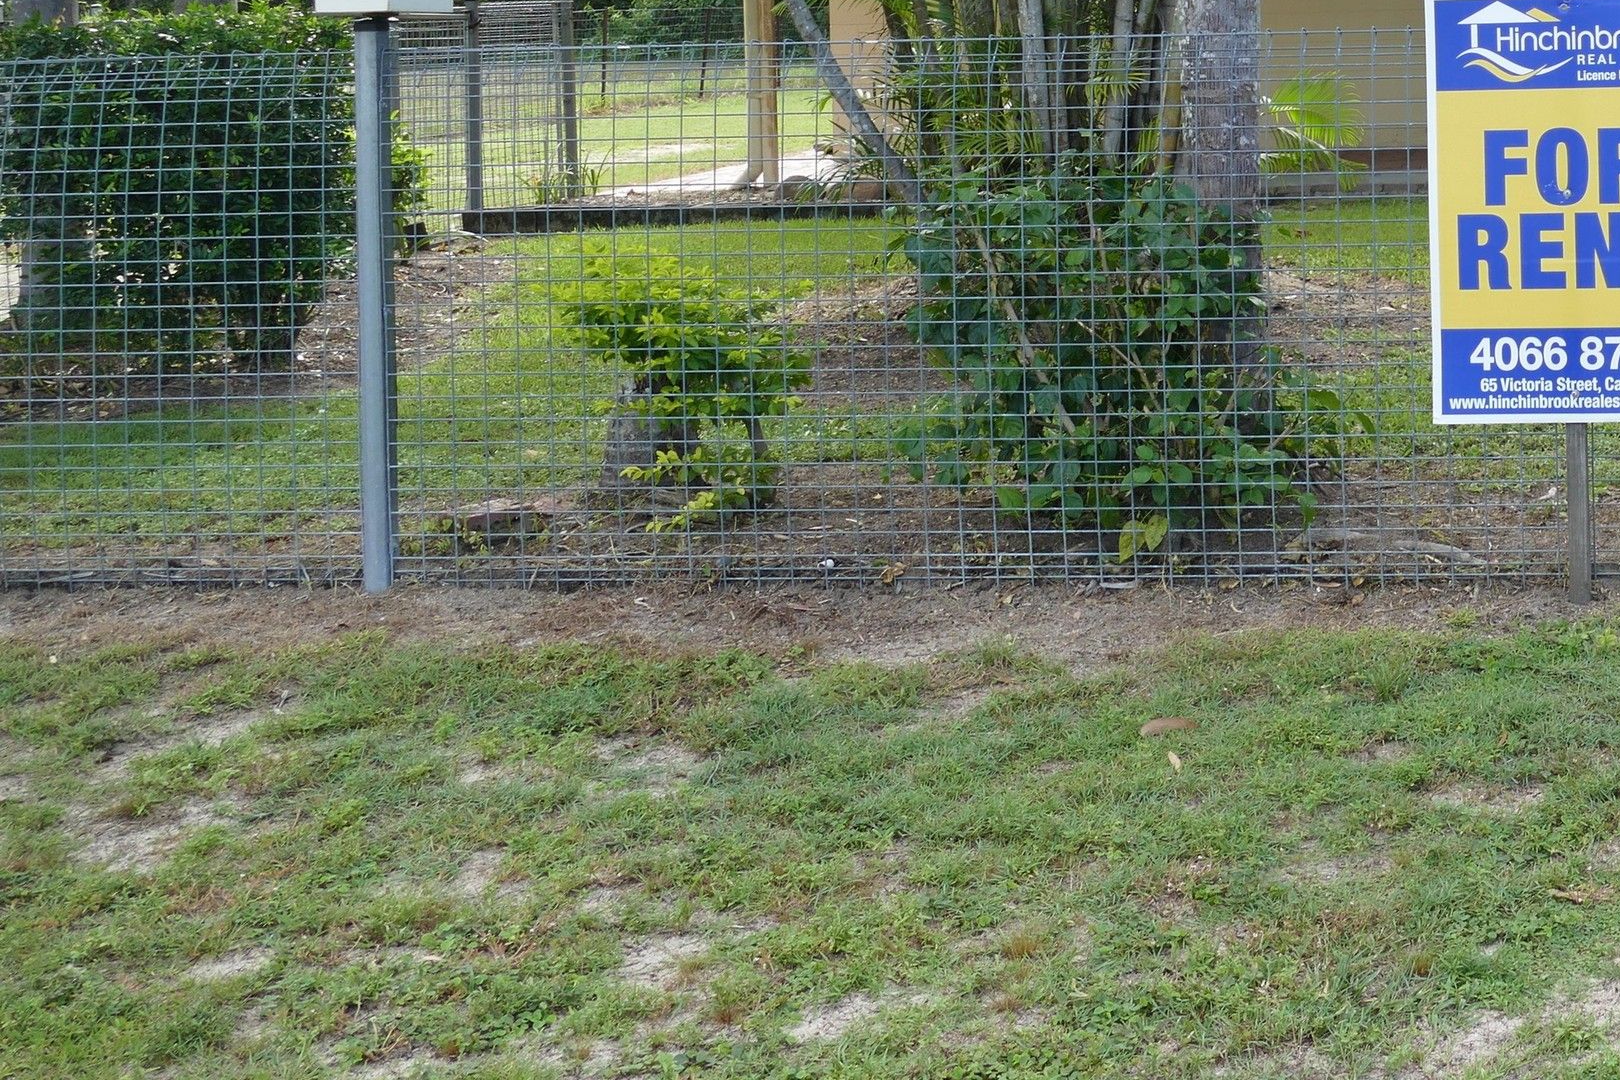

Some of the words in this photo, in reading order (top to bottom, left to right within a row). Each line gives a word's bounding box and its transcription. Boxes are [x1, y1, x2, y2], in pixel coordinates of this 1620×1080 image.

[1577, 53, 1616, 65] REAL
[1577, 69, 1616, 81] Licence
[1469, 336, 1567, 371] 4066
[1480, 379, 1498, 392] 65
[1500, 377, 1552, 392] Victoria
[1556, 377, 1602, 393] Street,
